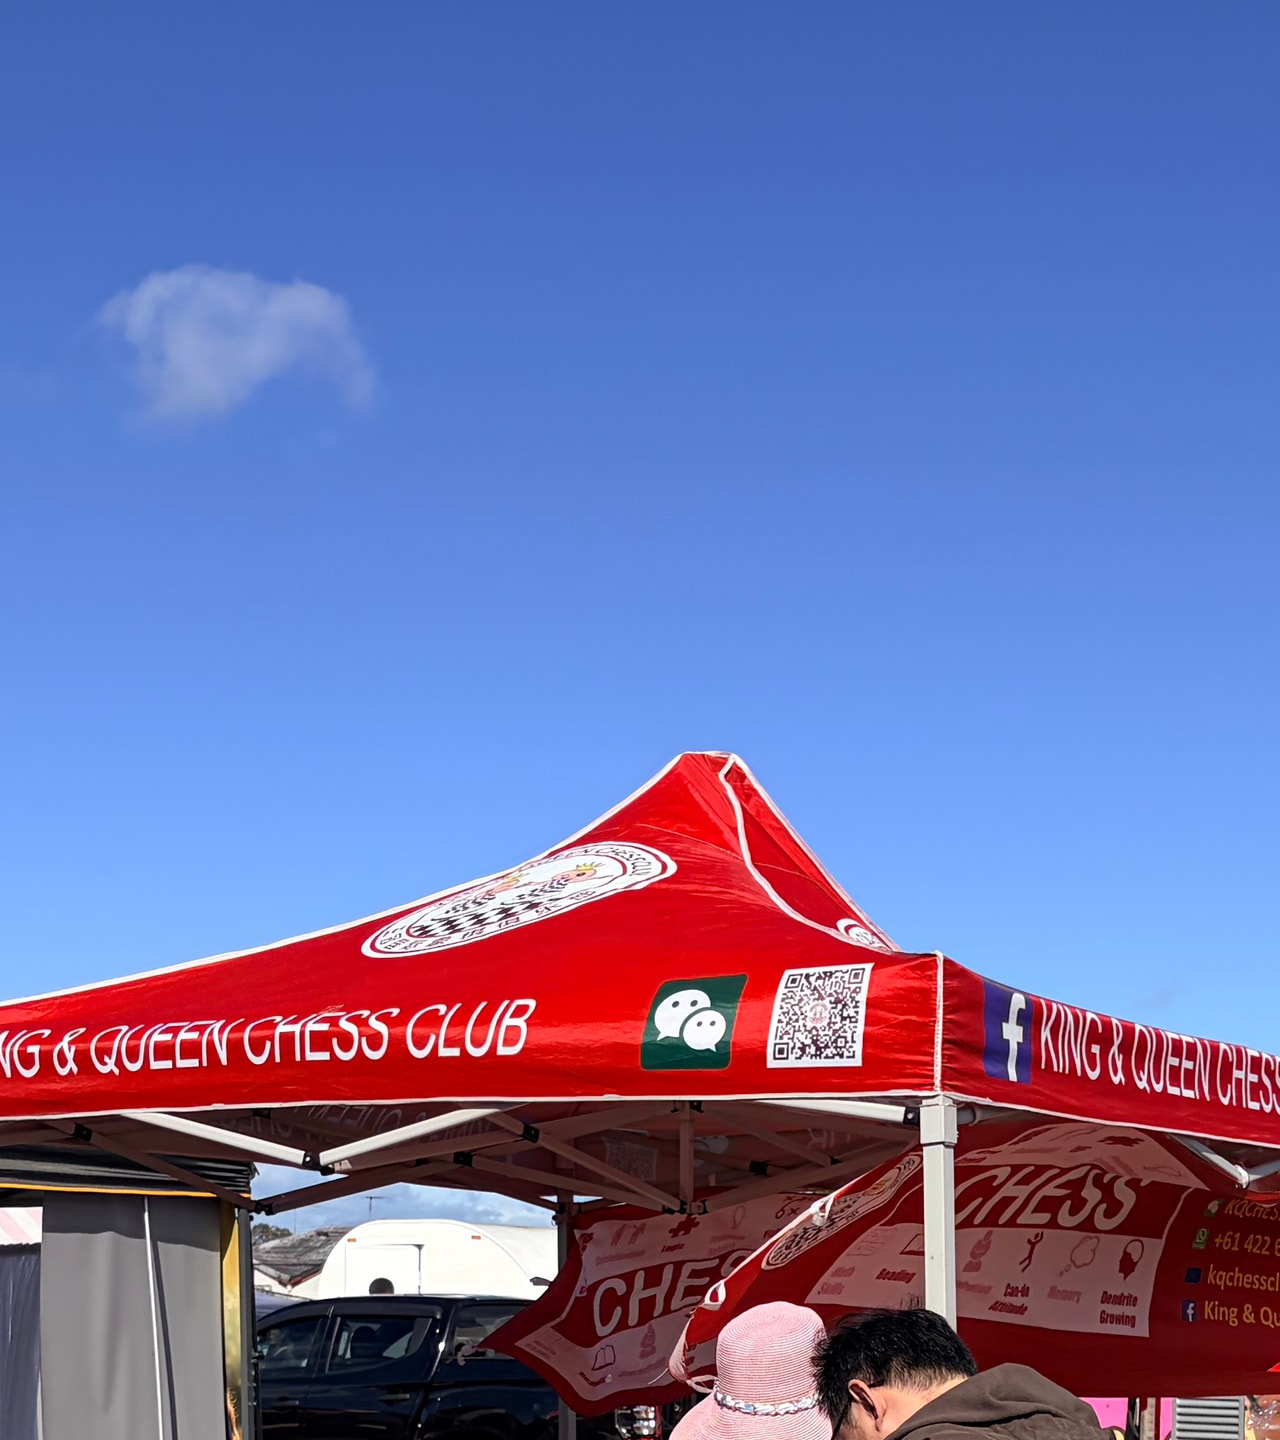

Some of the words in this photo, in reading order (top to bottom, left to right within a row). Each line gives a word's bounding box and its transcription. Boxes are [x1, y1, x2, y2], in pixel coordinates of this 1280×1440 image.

[52, 1028, 86, 1076] &
[90, 1019, 245, 1076] QUEEN
[243, 1008, 400, 1065] CHESS
[406, 998, 536, 1059] CLUB
[1039, 998, 1103, 1081] KING
[1109, 1017, 1126, 1086] &
[1131, 1024, 1211, 1102] QUEEN
[955, 1166, 1152, 1231] CHESS
[1214, 1232, 1240, 1251] +61
[1243, 1234, 1271, 1256] 422
[875, 1268, 917, 1284] Reading
[1100, 1290, 1138, 1308] Dendrite
[1100, 1309, 1137, 1329] Growing
[1204, 1301, 1238, 1327] King
[1242, 1304, 1255, 1324] &
